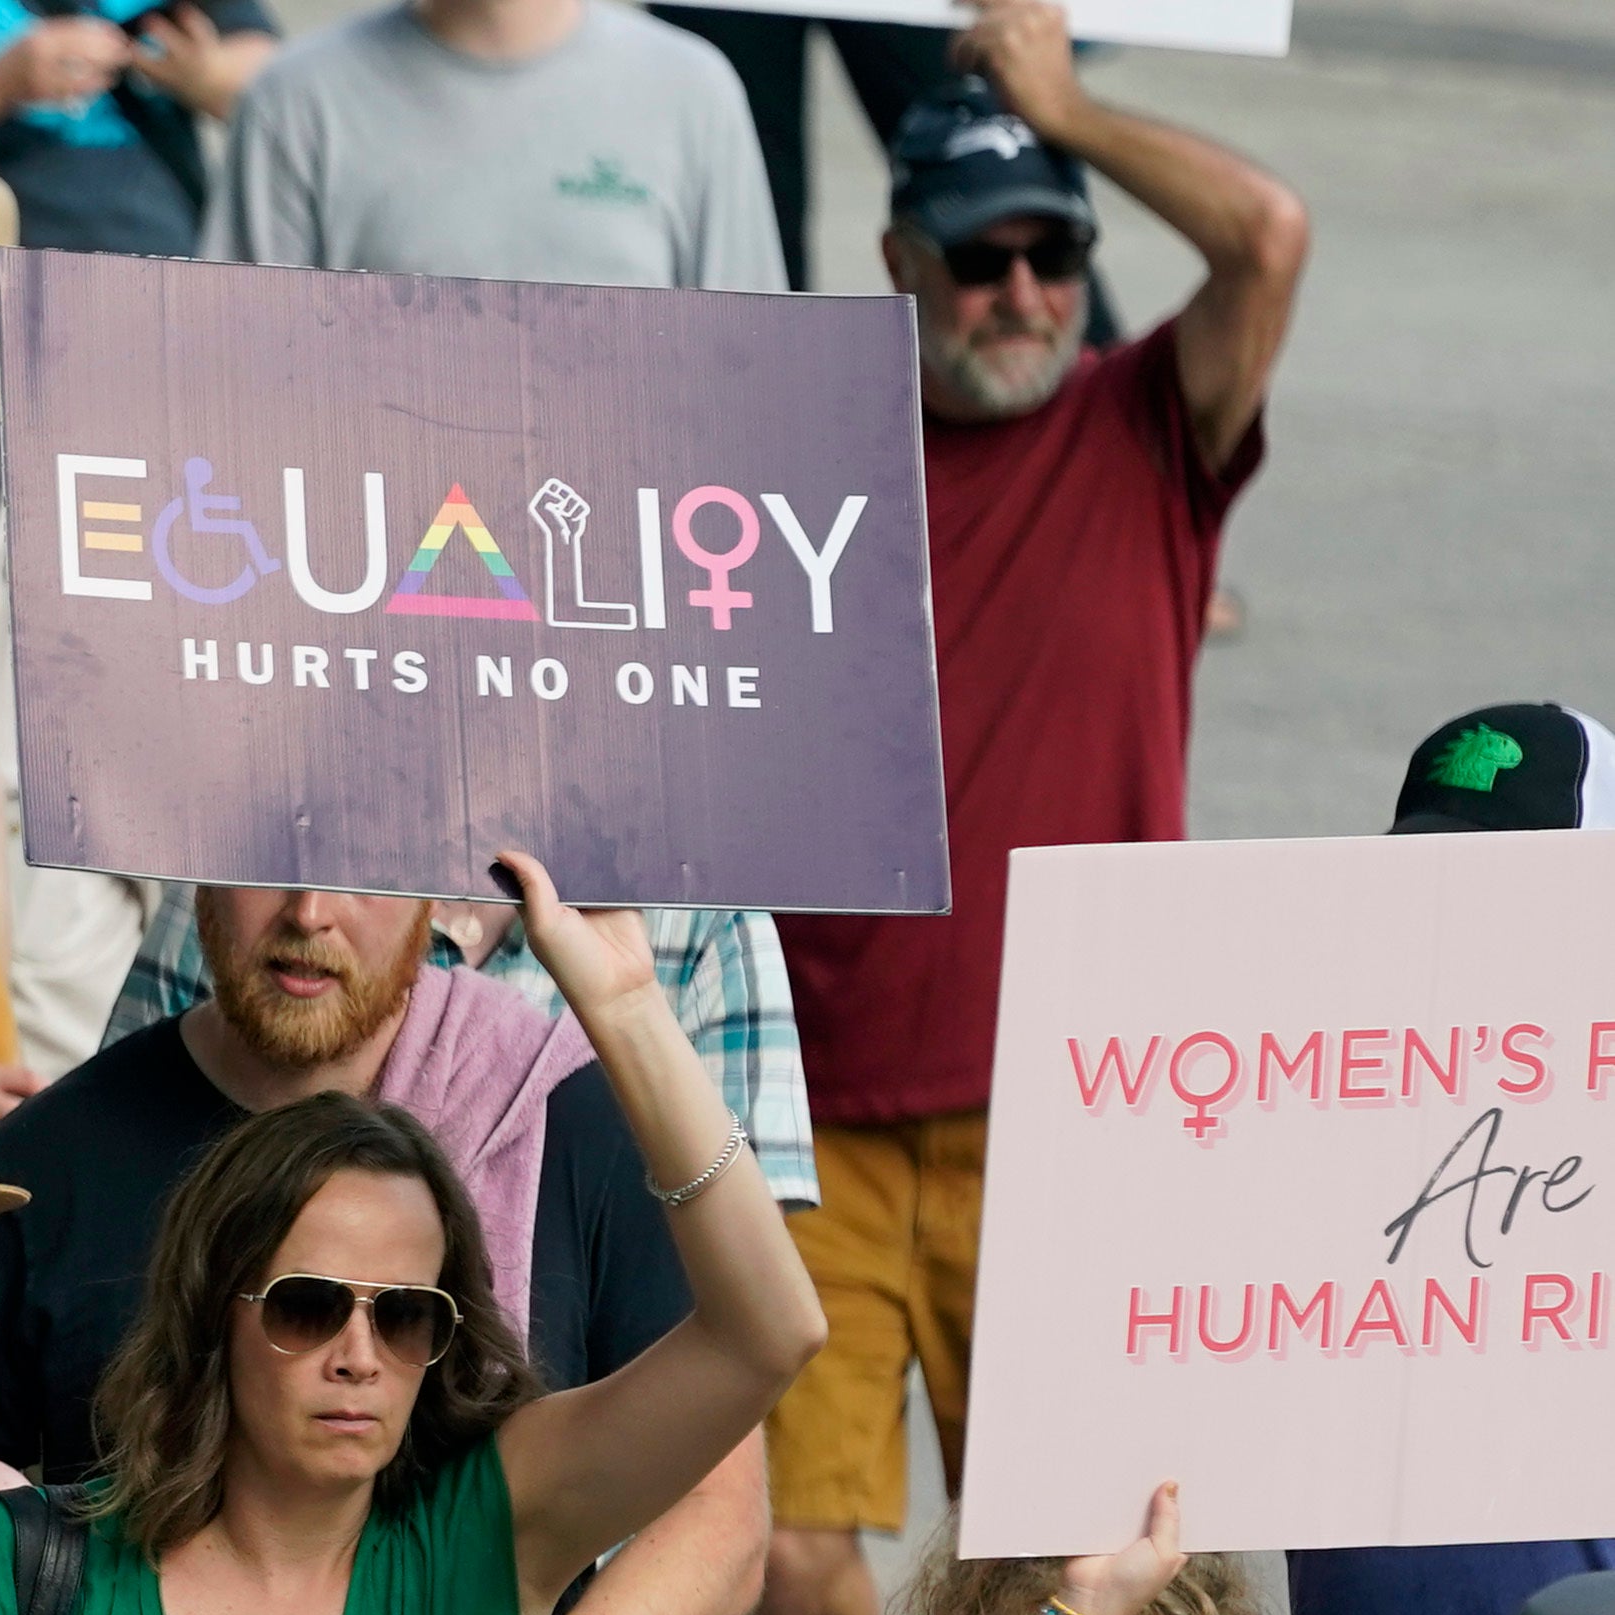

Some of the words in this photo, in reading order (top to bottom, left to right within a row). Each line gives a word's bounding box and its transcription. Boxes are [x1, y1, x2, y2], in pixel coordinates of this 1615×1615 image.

[181, 637, 430, 696] HURTS
[475, 655, 570, 703] NO
[615, 661, 764, 711] ONE
[1383, 1105, 1599, 1270] Are
[1125, 1275, 1488, 1360] HUMAN
